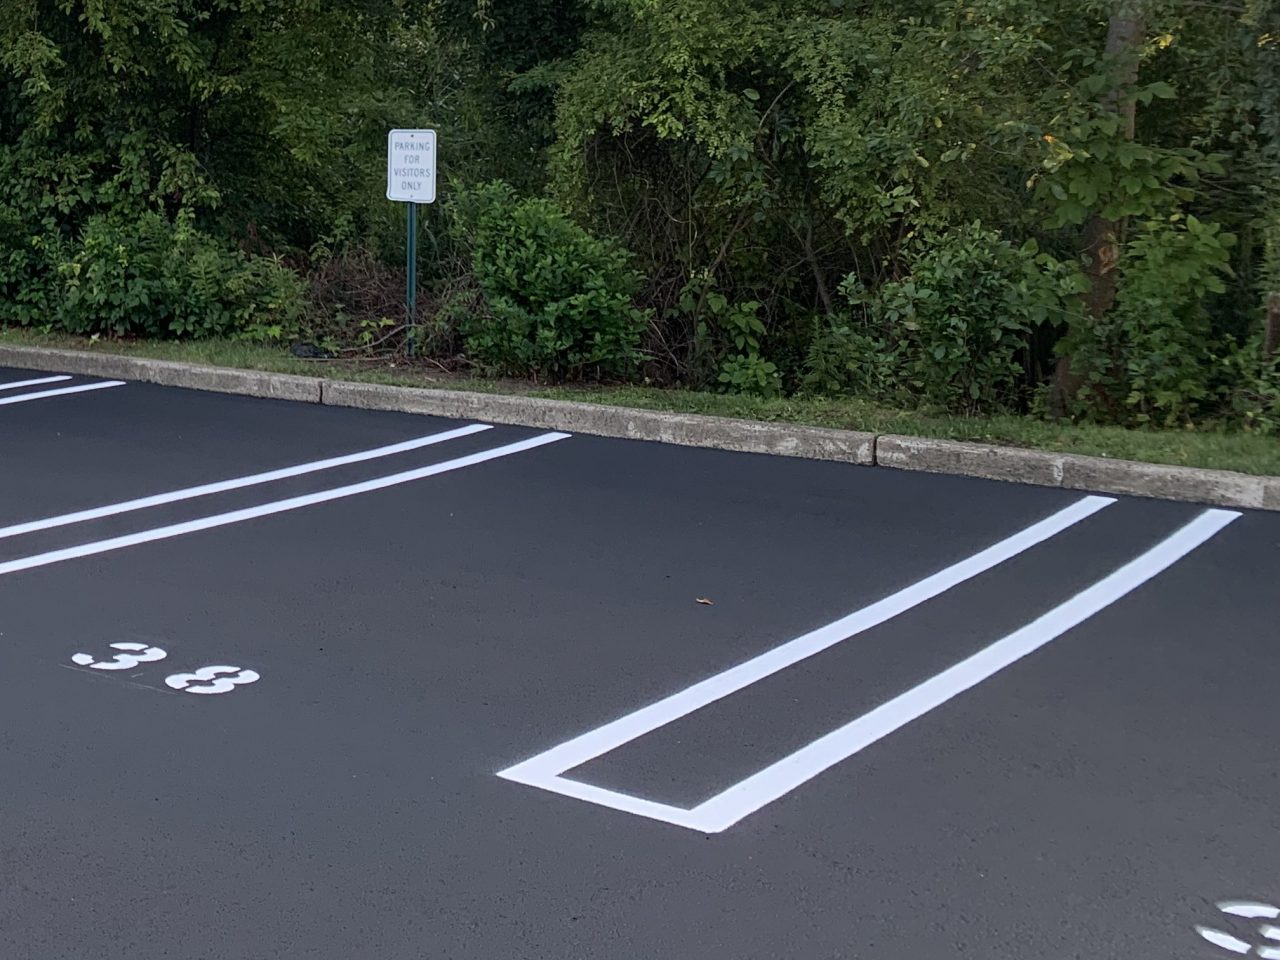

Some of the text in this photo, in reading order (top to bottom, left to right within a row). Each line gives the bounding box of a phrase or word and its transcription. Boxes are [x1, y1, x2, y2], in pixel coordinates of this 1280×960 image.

[394, 142, 431, 151] PARKING
[404, 155, 420, 164] FOR
[393, 168, 431, 177] VISITORS
[401, 181, 422, 191] ONLY
[71, 642, 261, 694] 38
